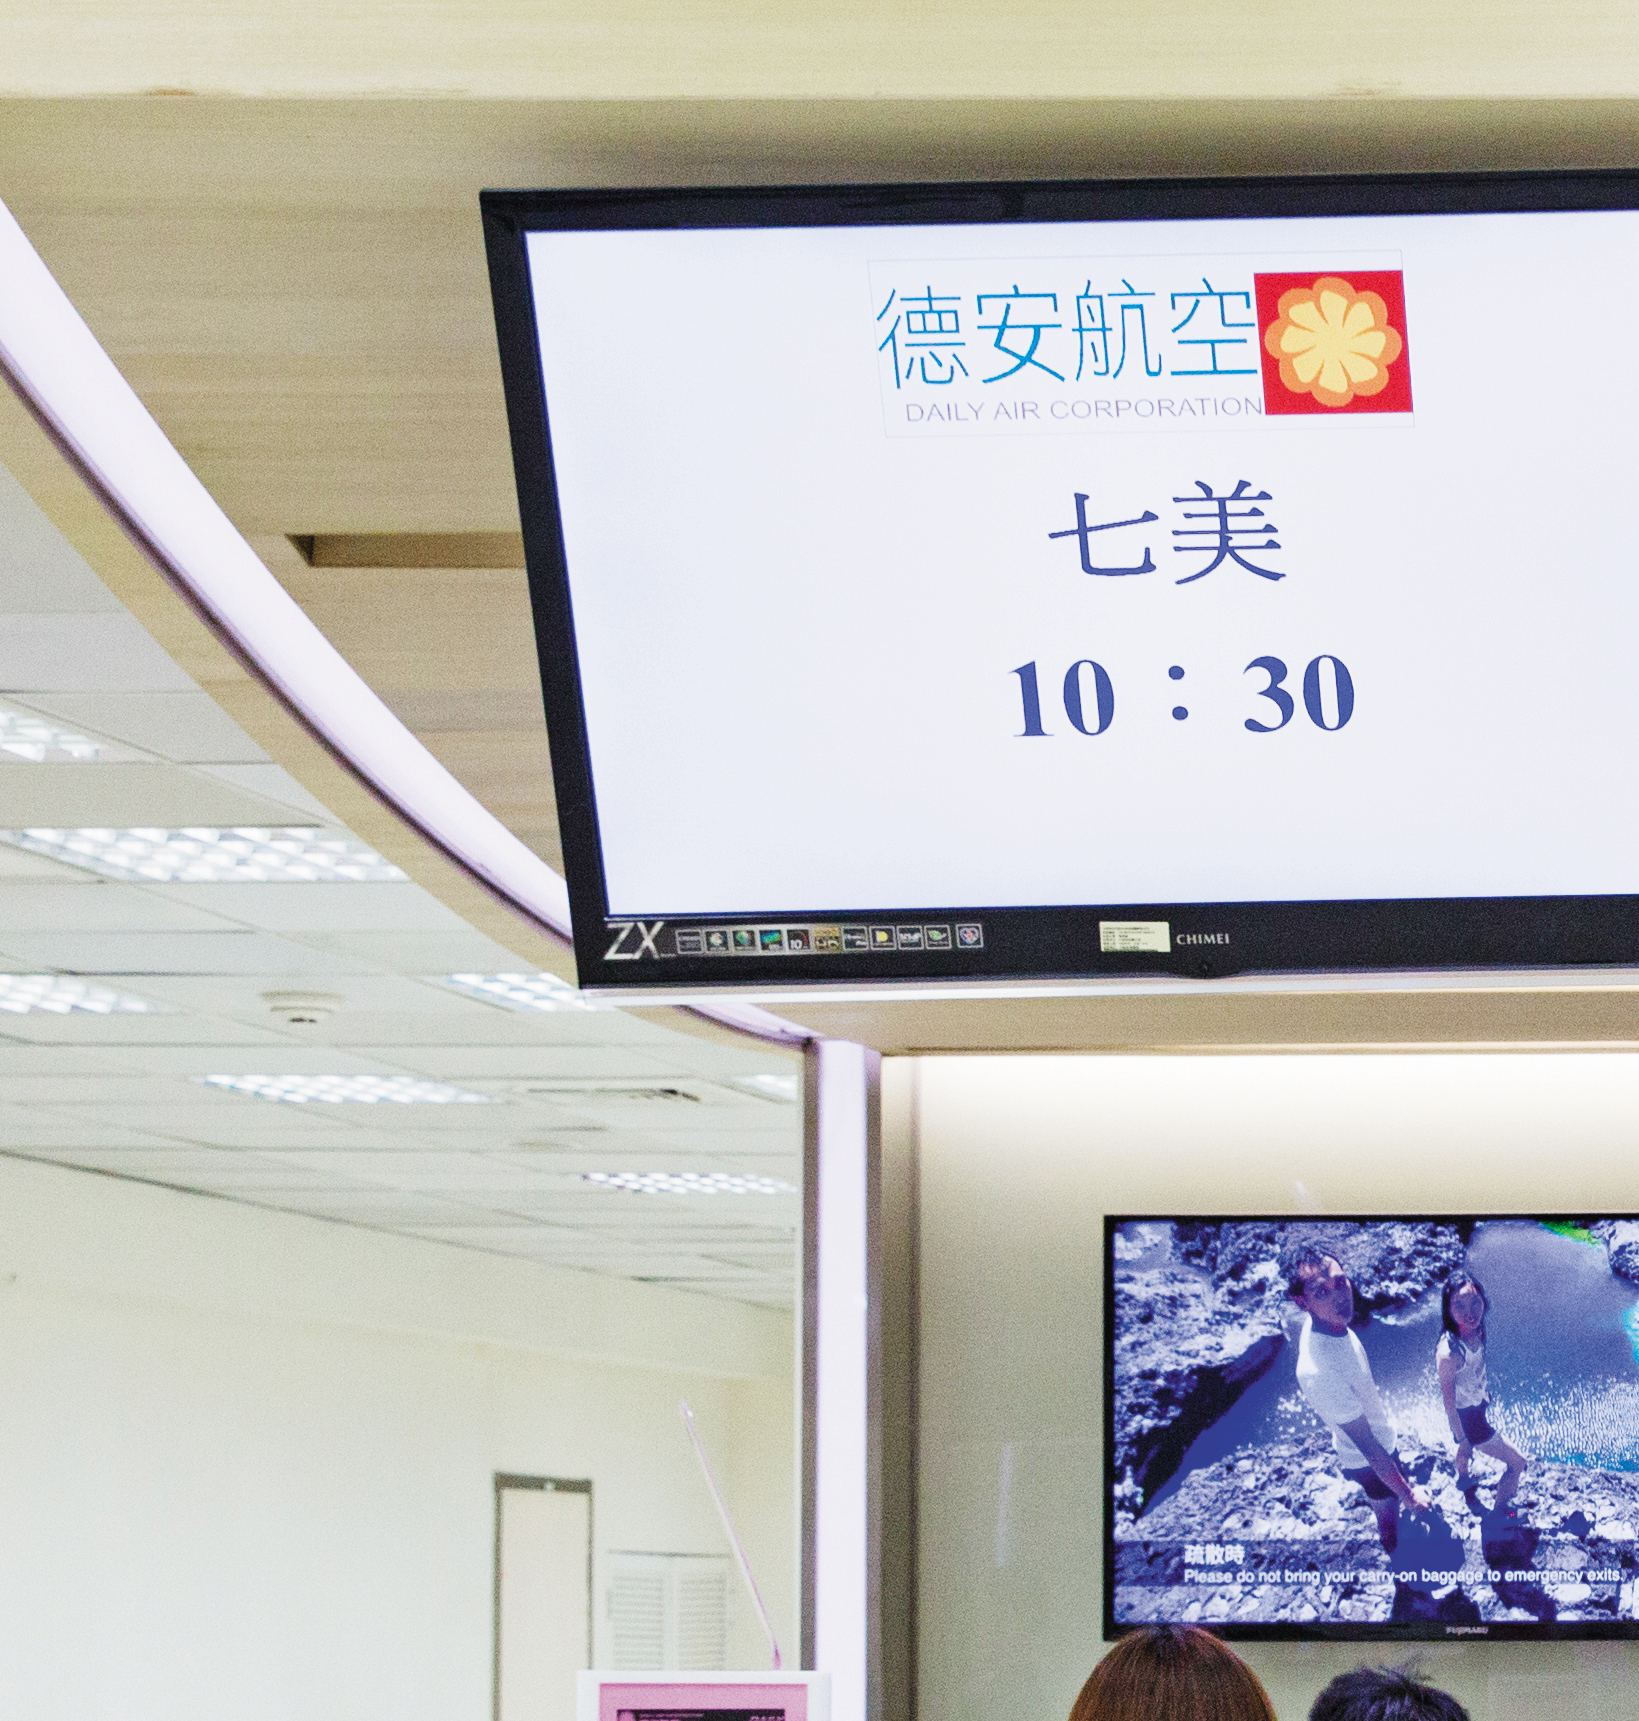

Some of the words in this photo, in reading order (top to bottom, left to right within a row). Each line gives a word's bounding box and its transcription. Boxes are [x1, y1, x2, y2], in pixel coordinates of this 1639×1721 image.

[876, 277, 1258, 389] 德安航空
[905, 402, 984, 423] DAILY
[994, 401, 1041, 420] AIR
[1050, 396, 1263, 419] CORPORATION
[1046, 478, 1288, 587] 七美
[1176, 932, 1230, 946] CHIMEI
[1184, 1569, 1232, 1583] Please
[1236, 1569, 1254, 1583] do
[1258, 1570, 1281, 1583] not
[1284, 1569, 1320, 1585] bring
[1324, 1572, 1355, 1585] your
[1358, 1571, 1417, 1584] carry-on
[1421, 1568, 1483, 1585] baggage
[1487, 1571, 1501, 1582] to
[1504, 1571, 1583, 1584] emergency
[1587, 1568, 1624, 1582] exits.
